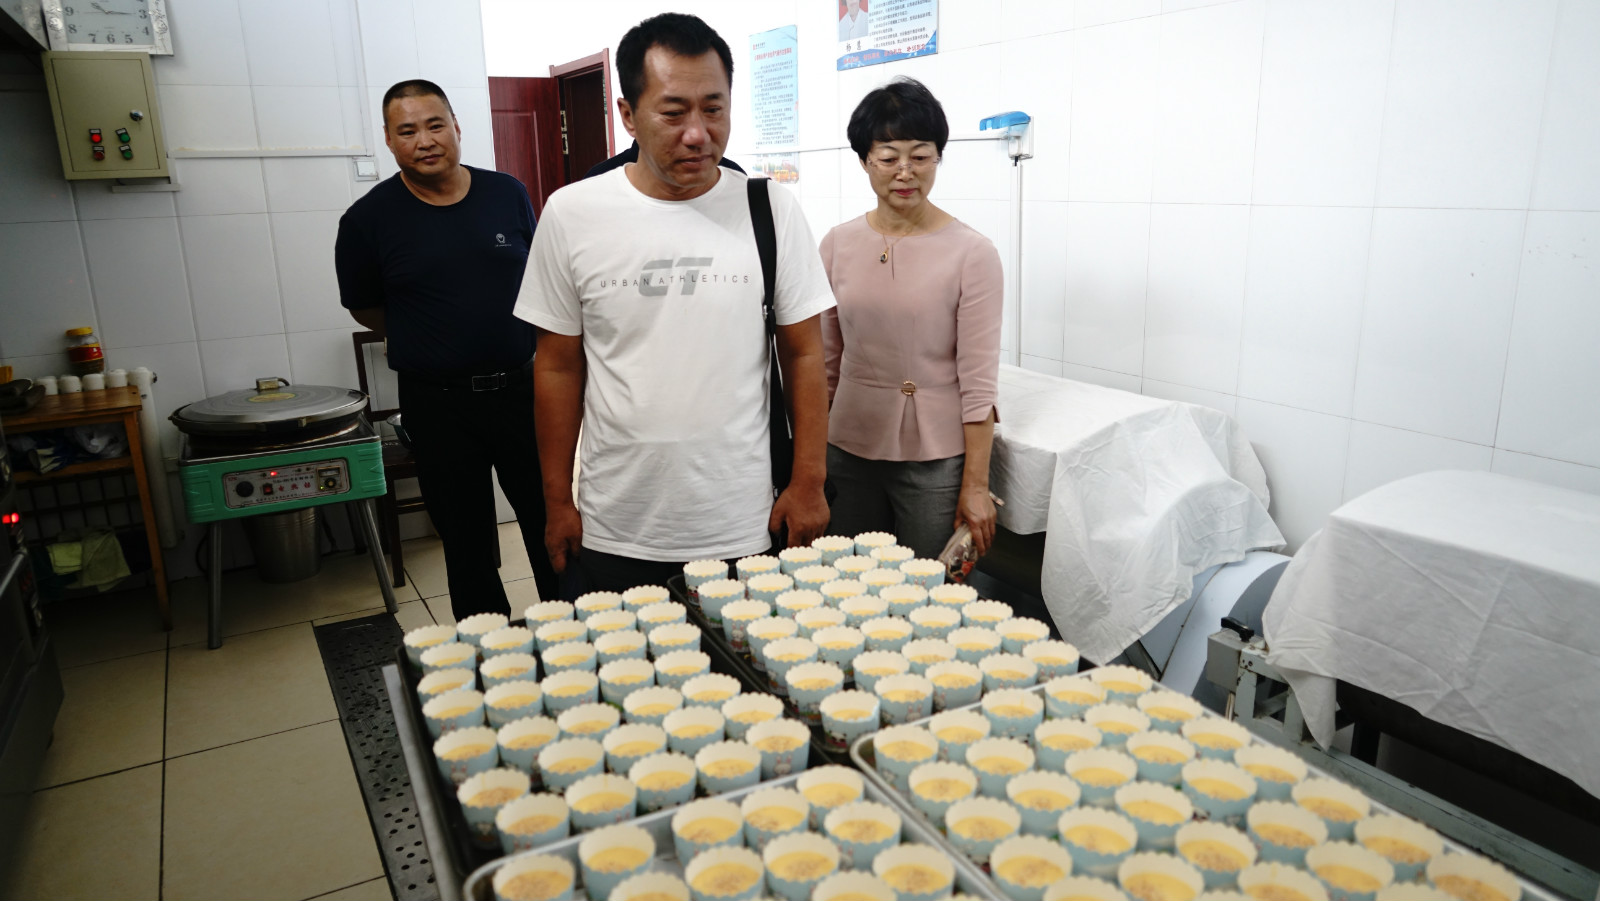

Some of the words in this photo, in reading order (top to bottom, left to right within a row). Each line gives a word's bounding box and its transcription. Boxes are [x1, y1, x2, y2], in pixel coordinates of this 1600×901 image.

[65, 7, 74, 16] 9
[139, 10, 147, 19] 3
[68, 24, 77, 34] 8
[142, 27, 149, 36] 4
[88, 33, 96, 43] 7
[106, 34, 115, 43] 6
[125, 34, 133, 43] 5
[600, 278, 650, 288] URBAN
[659, 275, 749, 285] ATHLETICS
